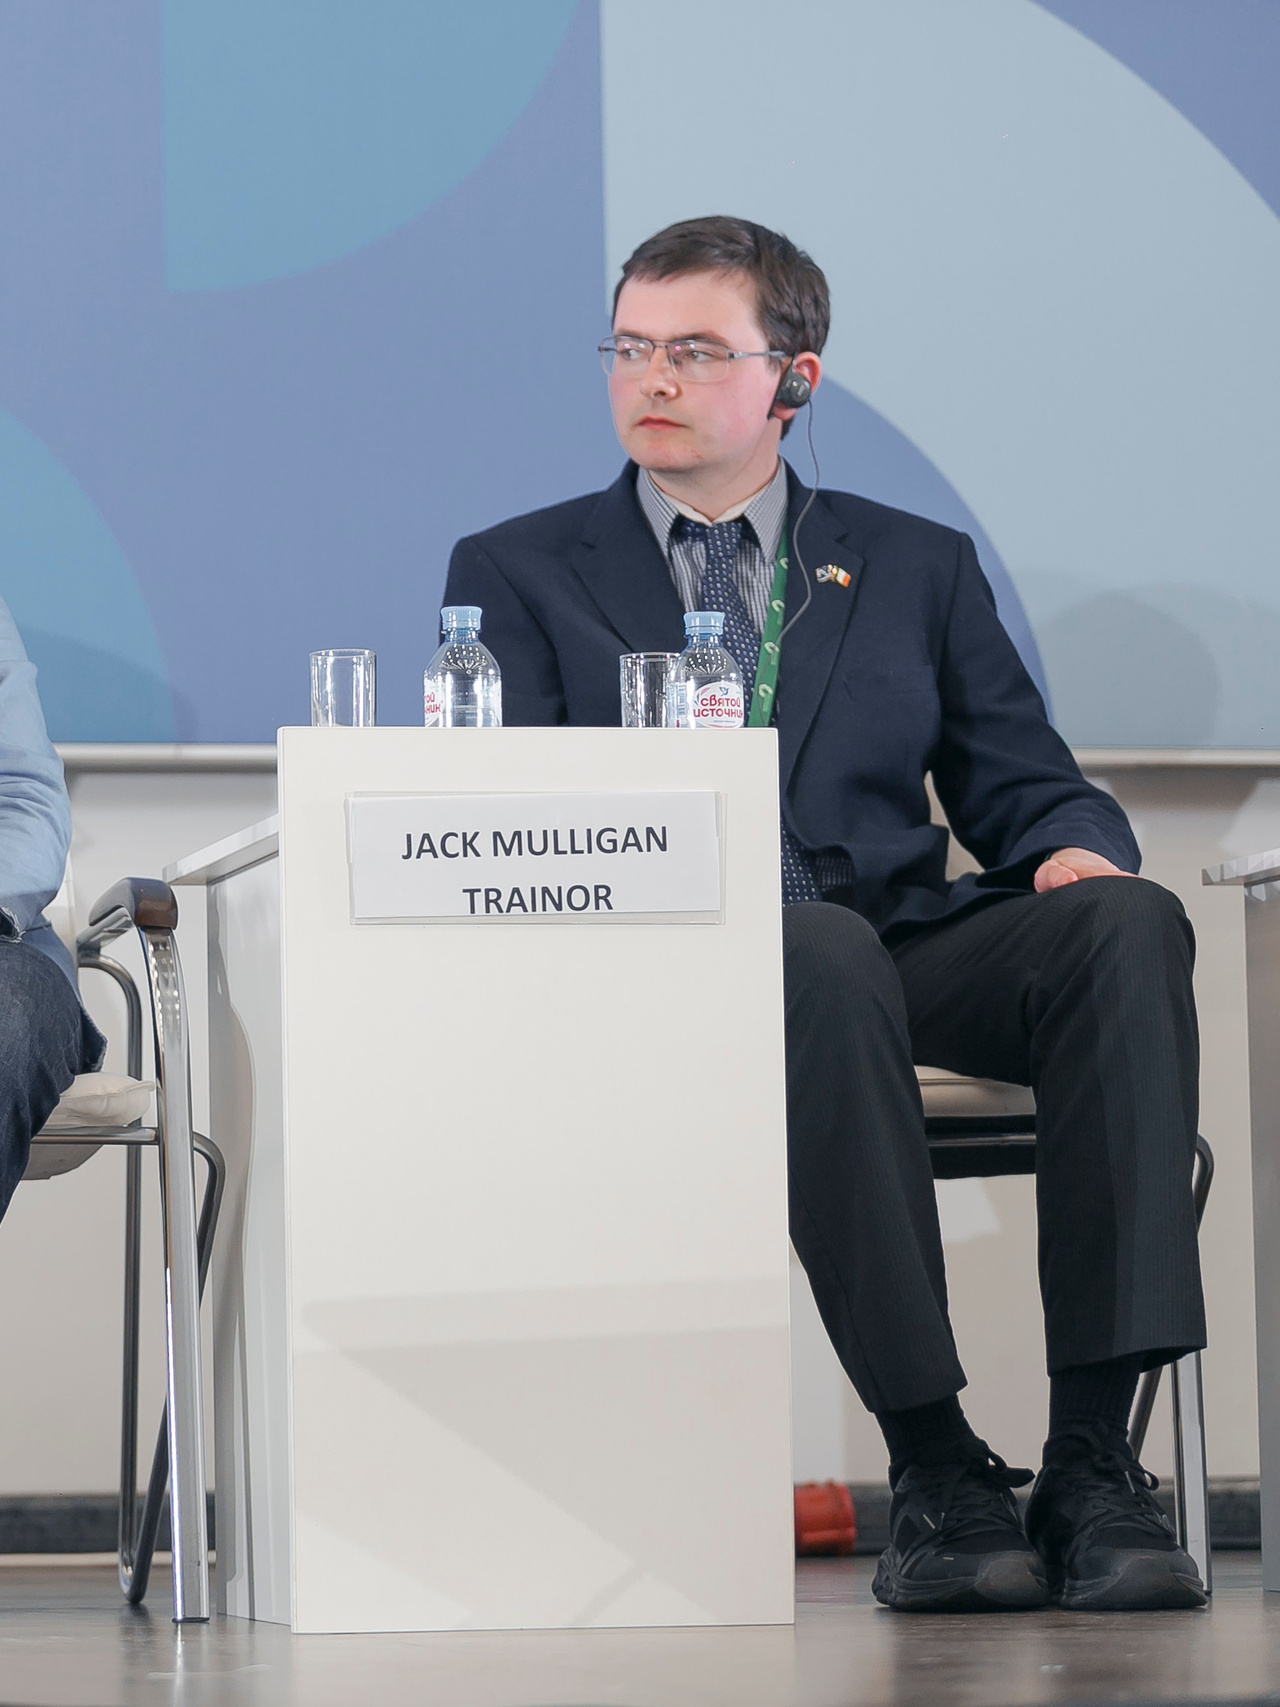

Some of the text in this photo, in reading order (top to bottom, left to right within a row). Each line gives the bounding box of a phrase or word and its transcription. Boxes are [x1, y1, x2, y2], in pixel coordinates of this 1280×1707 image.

[402, 826, 668, 859] JACK MULLIGAN
[462, 884, 614, 914] TRAINOR
